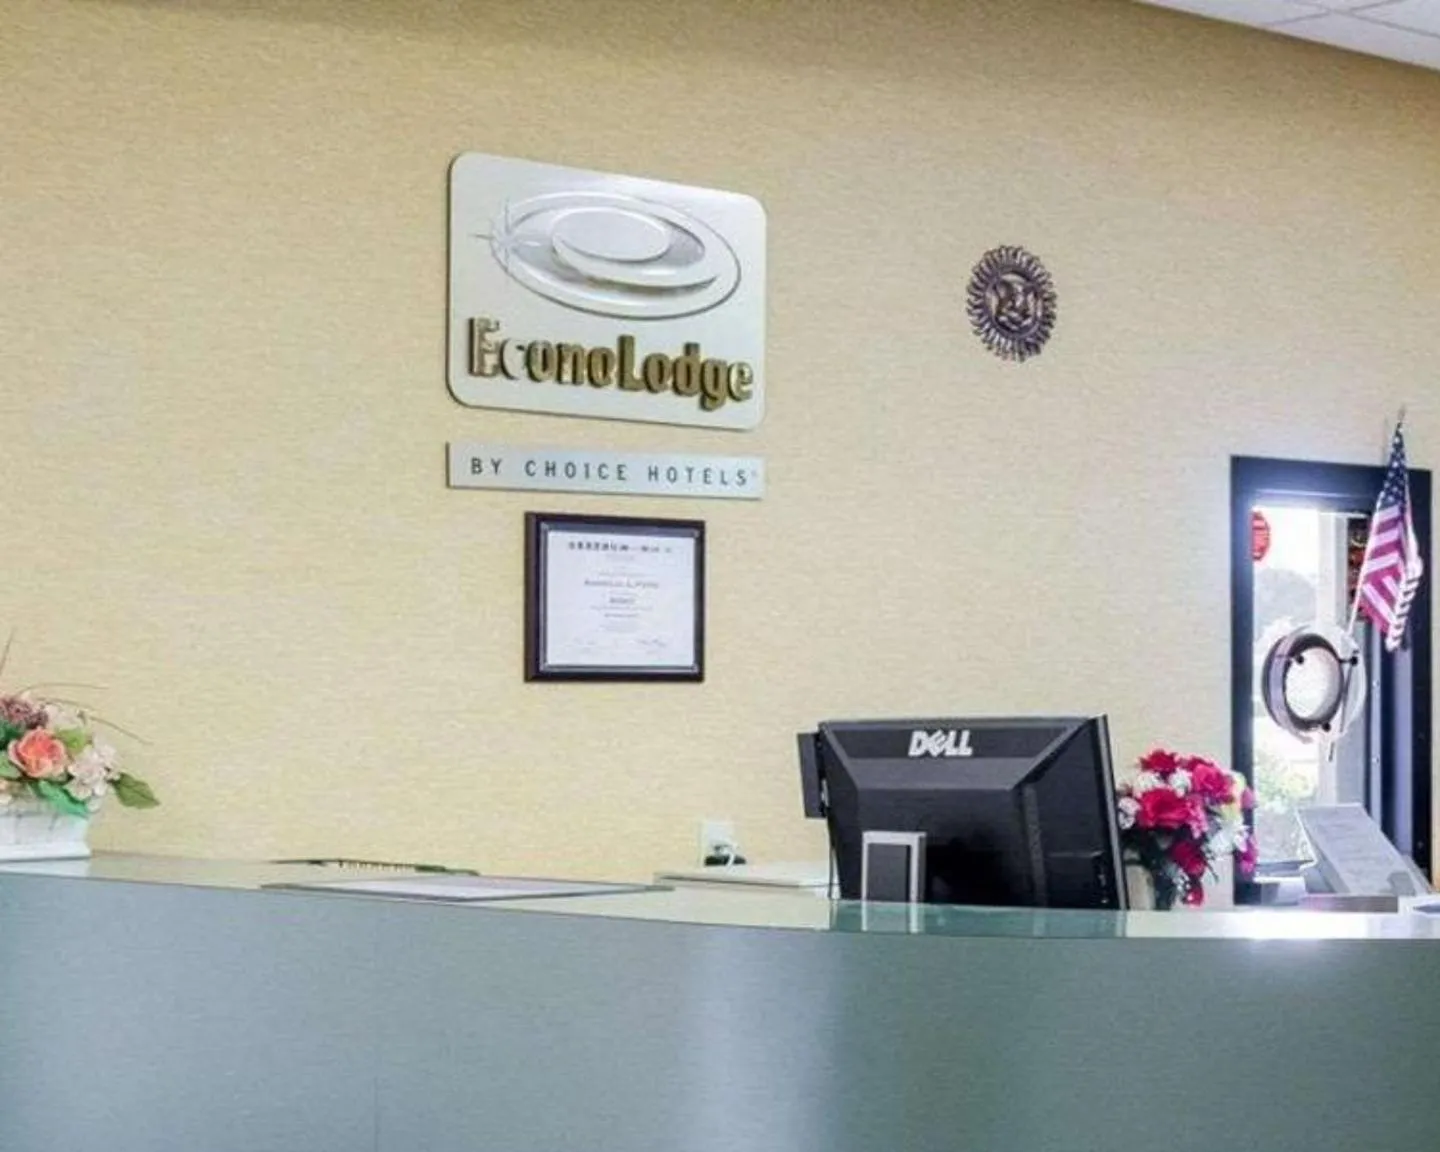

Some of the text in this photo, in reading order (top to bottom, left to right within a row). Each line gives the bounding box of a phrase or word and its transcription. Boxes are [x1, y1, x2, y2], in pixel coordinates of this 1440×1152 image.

[467, 316, 754, 412] EconoLodge
[471, 457, 748, 487] BY CHOICE HOTELS
[908, 729, 974, 757] DELL
